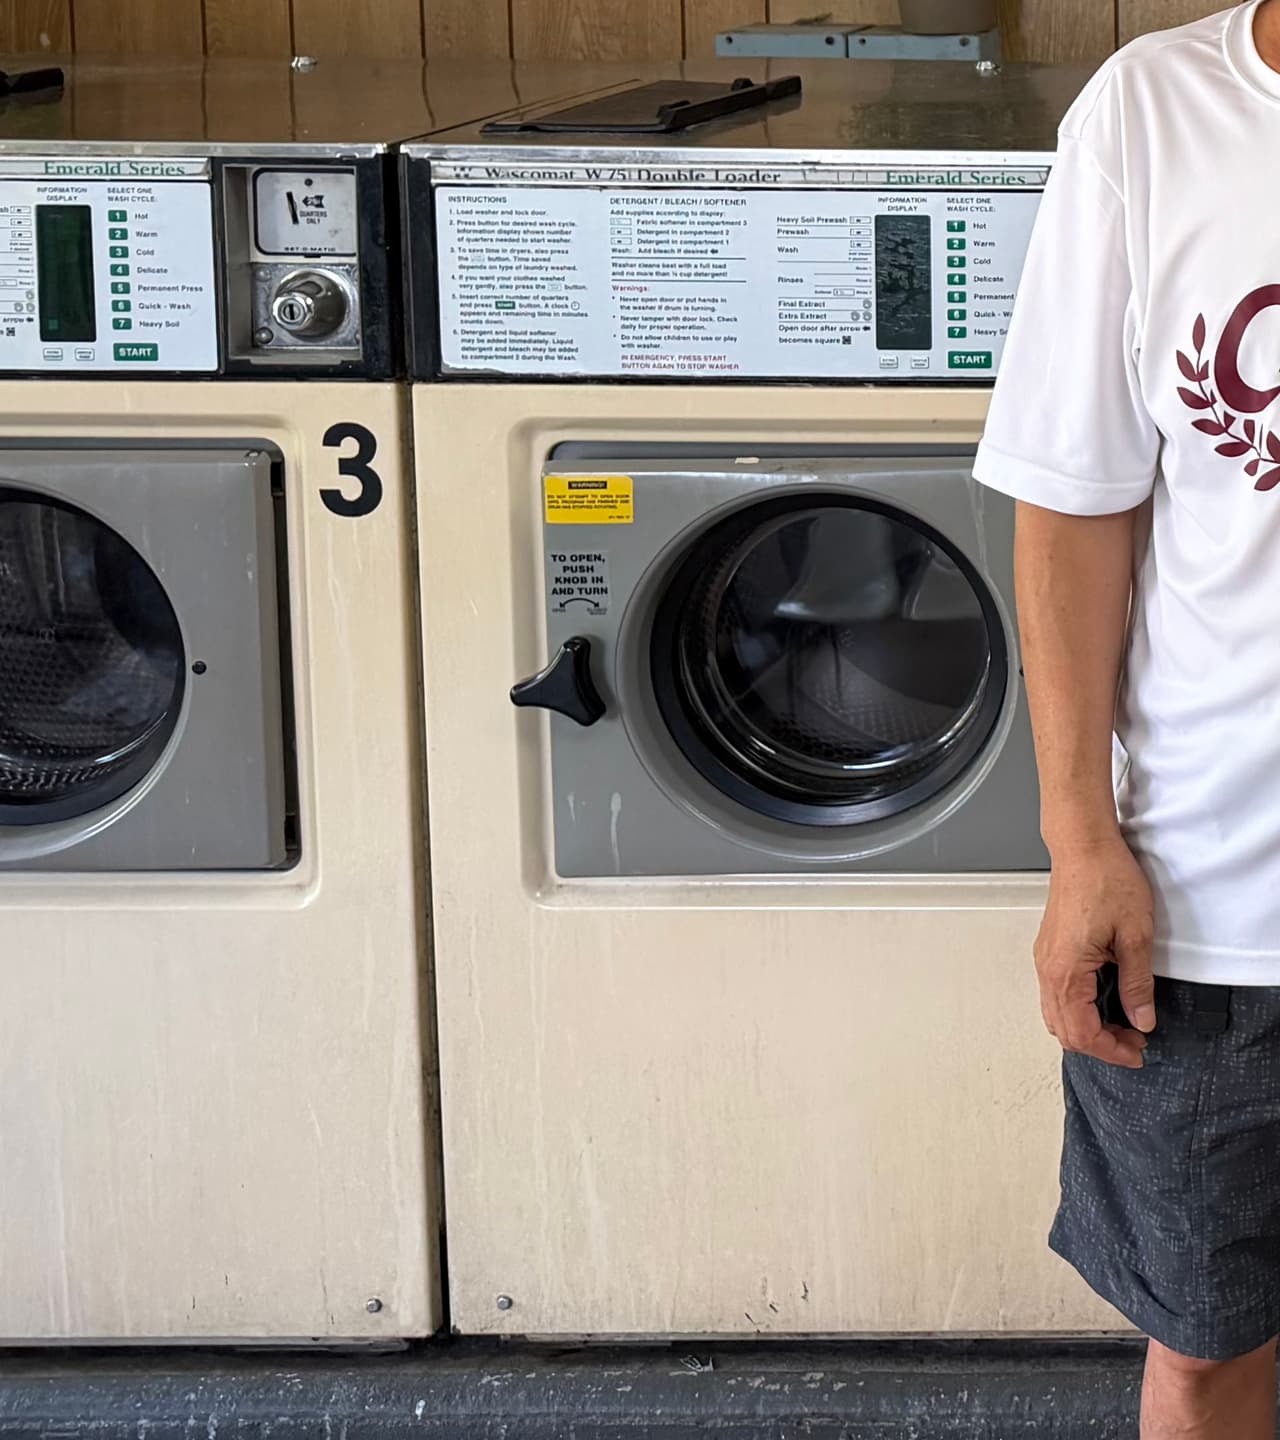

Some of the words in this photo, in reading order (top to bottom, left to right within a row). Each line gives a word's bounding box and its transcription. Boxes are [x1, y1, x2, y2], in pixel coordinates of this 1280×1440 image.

[44, 161, 121, 176] Emerald
[129, 162, 185, 176] Series
[485, 168, 577, 180] Wascomat
[637, 169, 706, 182] Double
[714, 169, 781, 182] Loader
[886, 171, 962, 185] Emerald
[970, 171, 1025, 185] Series
[119, 346, 153, 358] START
[953, 355, 987, 365] START
[319, 422, 384, 517] 3
[551, 553, 567, 563] TO
[570, 553, 606, 564] OPEN,
[562, 565, 595, 574] PUSH
[554, 576, 588, 585] KNOB
[591, 576, 604, 585] IN
[551, 587, 574, 596] AND
[576, 587, 609, 596] TURN
